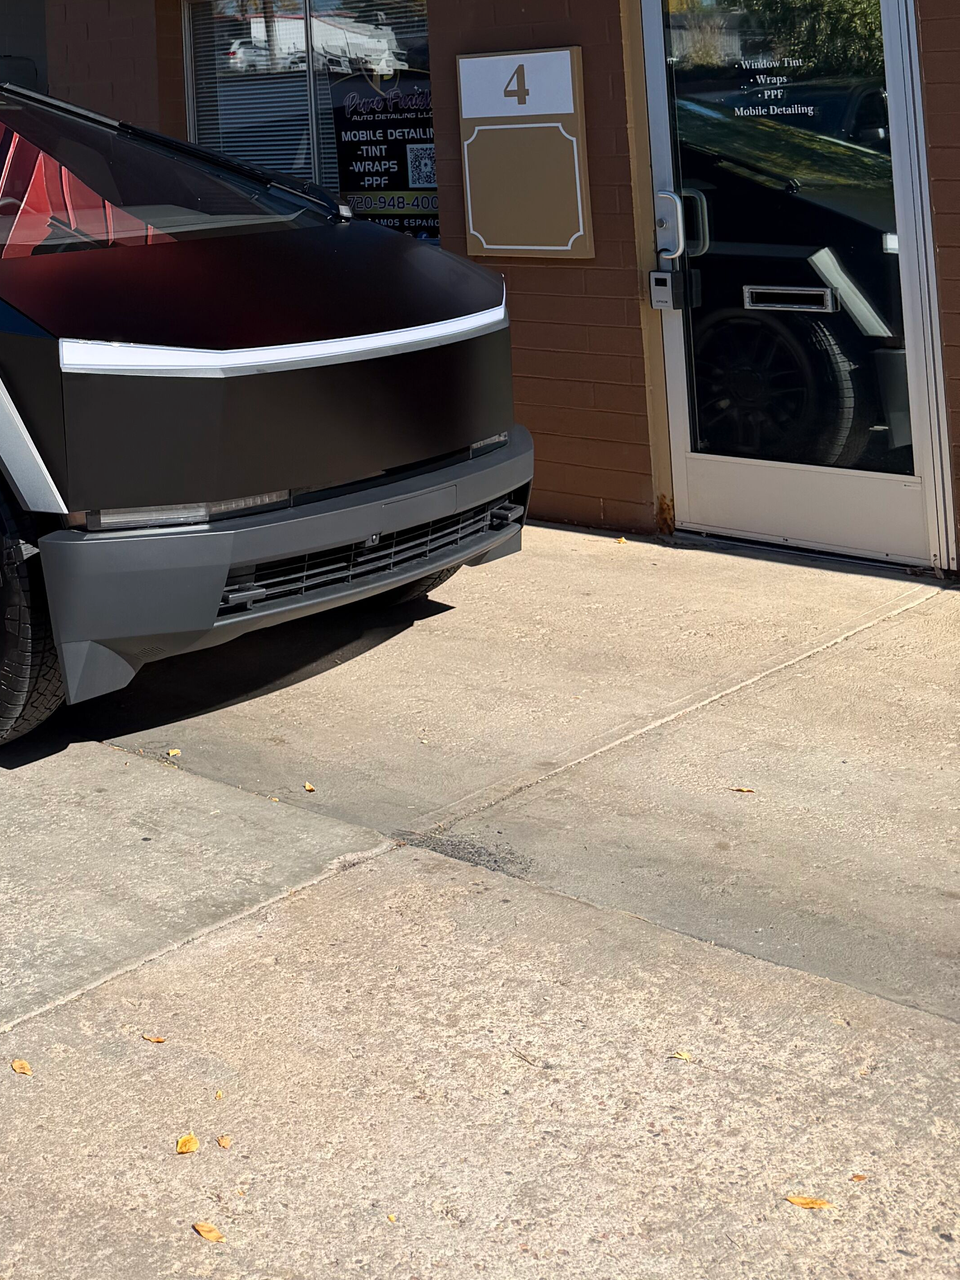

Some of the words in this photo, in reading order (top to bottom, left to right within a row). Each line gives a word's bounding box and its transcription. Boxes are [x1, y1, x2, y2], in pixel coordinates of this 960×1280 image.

[740, 58, 780, 70] Window
[782, 57, 803, 67] Tint
[503, 63, 530, 105] 4
[755, 74, 788, 86] Wraps
[764, 89, 784, 100] PPF
[343, 91, 384, 118] Pure
[734, 106, 768, 117] Mobile
[769, 104, 814, 117] Detailing
[375, 112, 416, 120] DETAILING
[341, 129, 384, 142] MOBILE
[387, 127, 435, 140] DETAILIN
[357, 145, 388, 157] -TINT
[349, 160, 398, 173] -WRAPS
[360, 176, 389, 188] -PPF
[346, 194, 439, 211] 720-948-400
[403, 217, 440, 227] ESPAÑO
